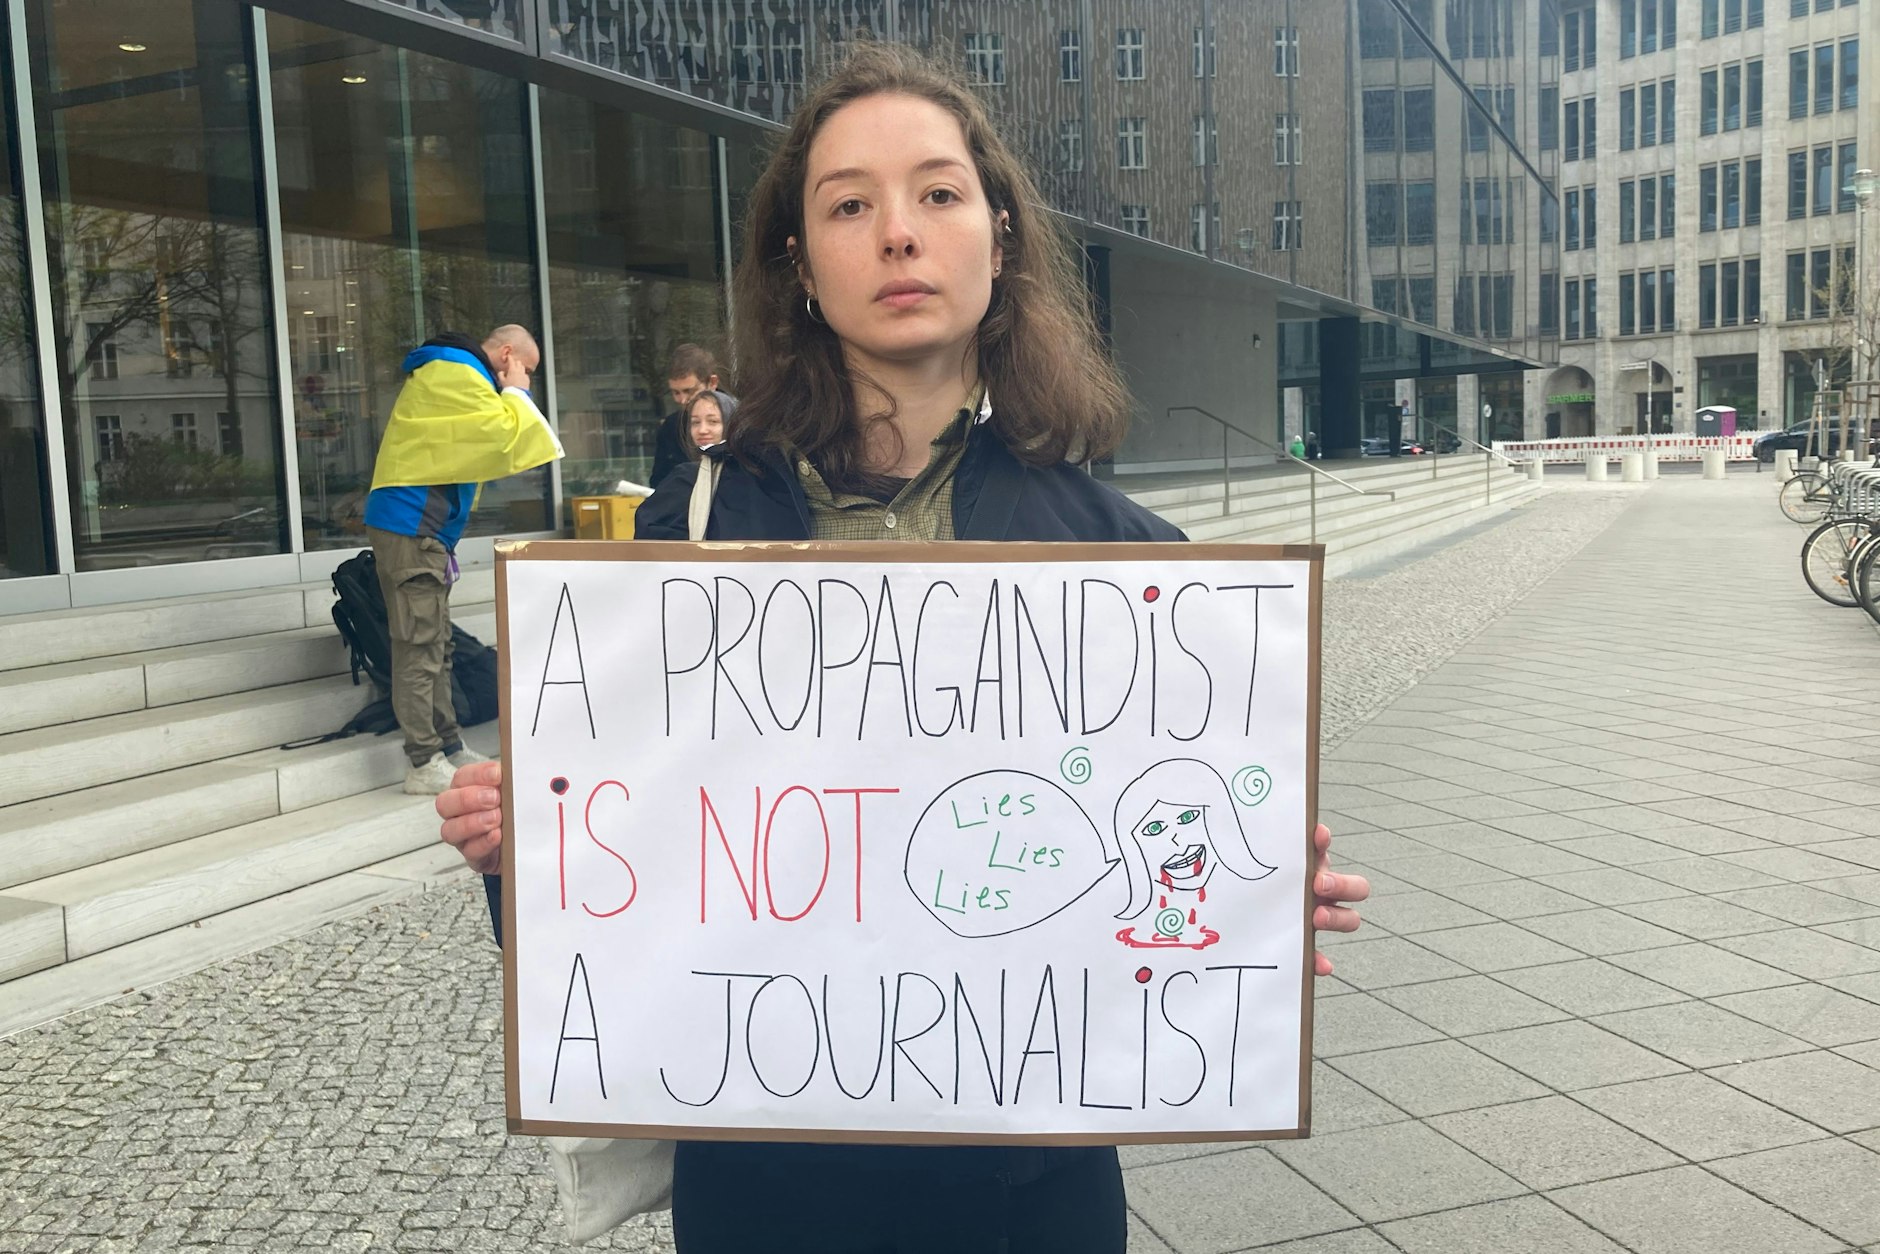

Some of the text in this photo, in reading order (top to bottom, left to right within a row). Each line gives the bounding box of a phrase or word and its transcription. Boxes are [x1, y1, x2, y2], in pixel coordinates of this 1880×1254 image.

[532, 581, 597, 739] A
[699, 784, 901, 924] NOT
[951, 793, 1036, 829] Lies
[988, 831, 1065, 873] Lies
[935, 869, 1012, 914] Lies
[549, 952, 608, 1105] A
